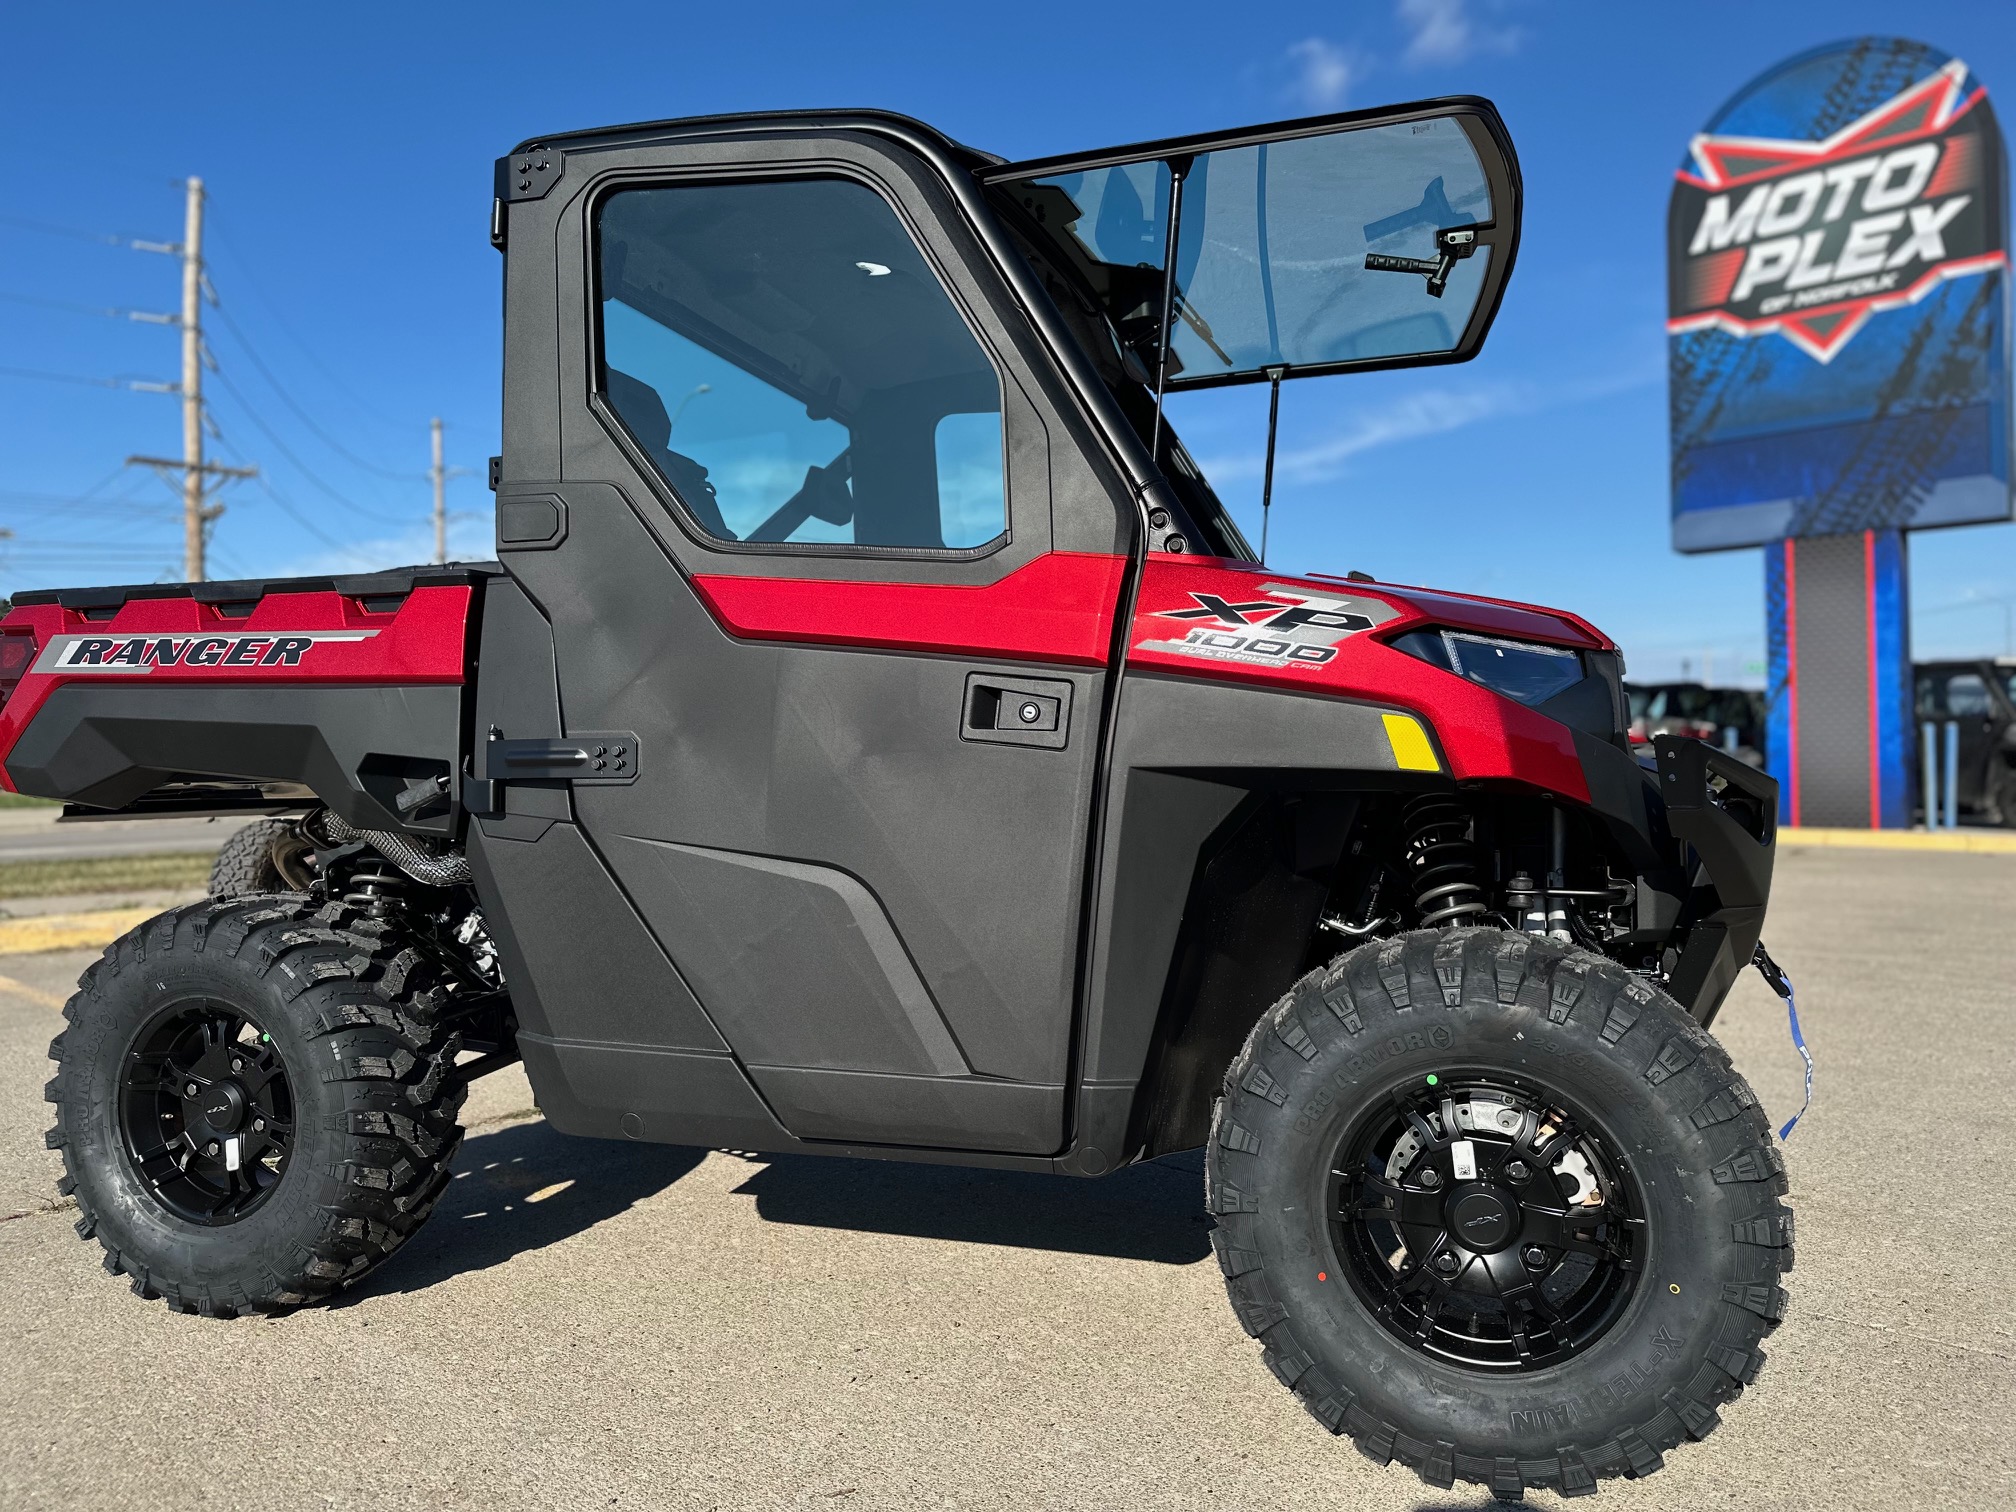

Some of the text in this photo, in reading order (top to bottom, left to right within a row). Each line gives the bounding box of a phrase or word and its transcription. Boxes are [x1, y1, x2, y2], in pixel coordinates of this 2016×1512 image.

[1688, 143, 1939, 255] MOTO
[1730, 196, 1971, 302] PLEX
[1759, 271, 1900, 314] OF NORFOLK
[1152, 591, 1377, 634] XP
[66, 637, 312, 667] RANGER
[1178, 645, 1323, 671] DUAL OVERHEAD CAM
[1184, 627, 1339, 664] 1000
[1293, 1031, 1426, 1137] PRO ARMOR
[1510, 1323, 1685, 1437] X-TERRAIN
